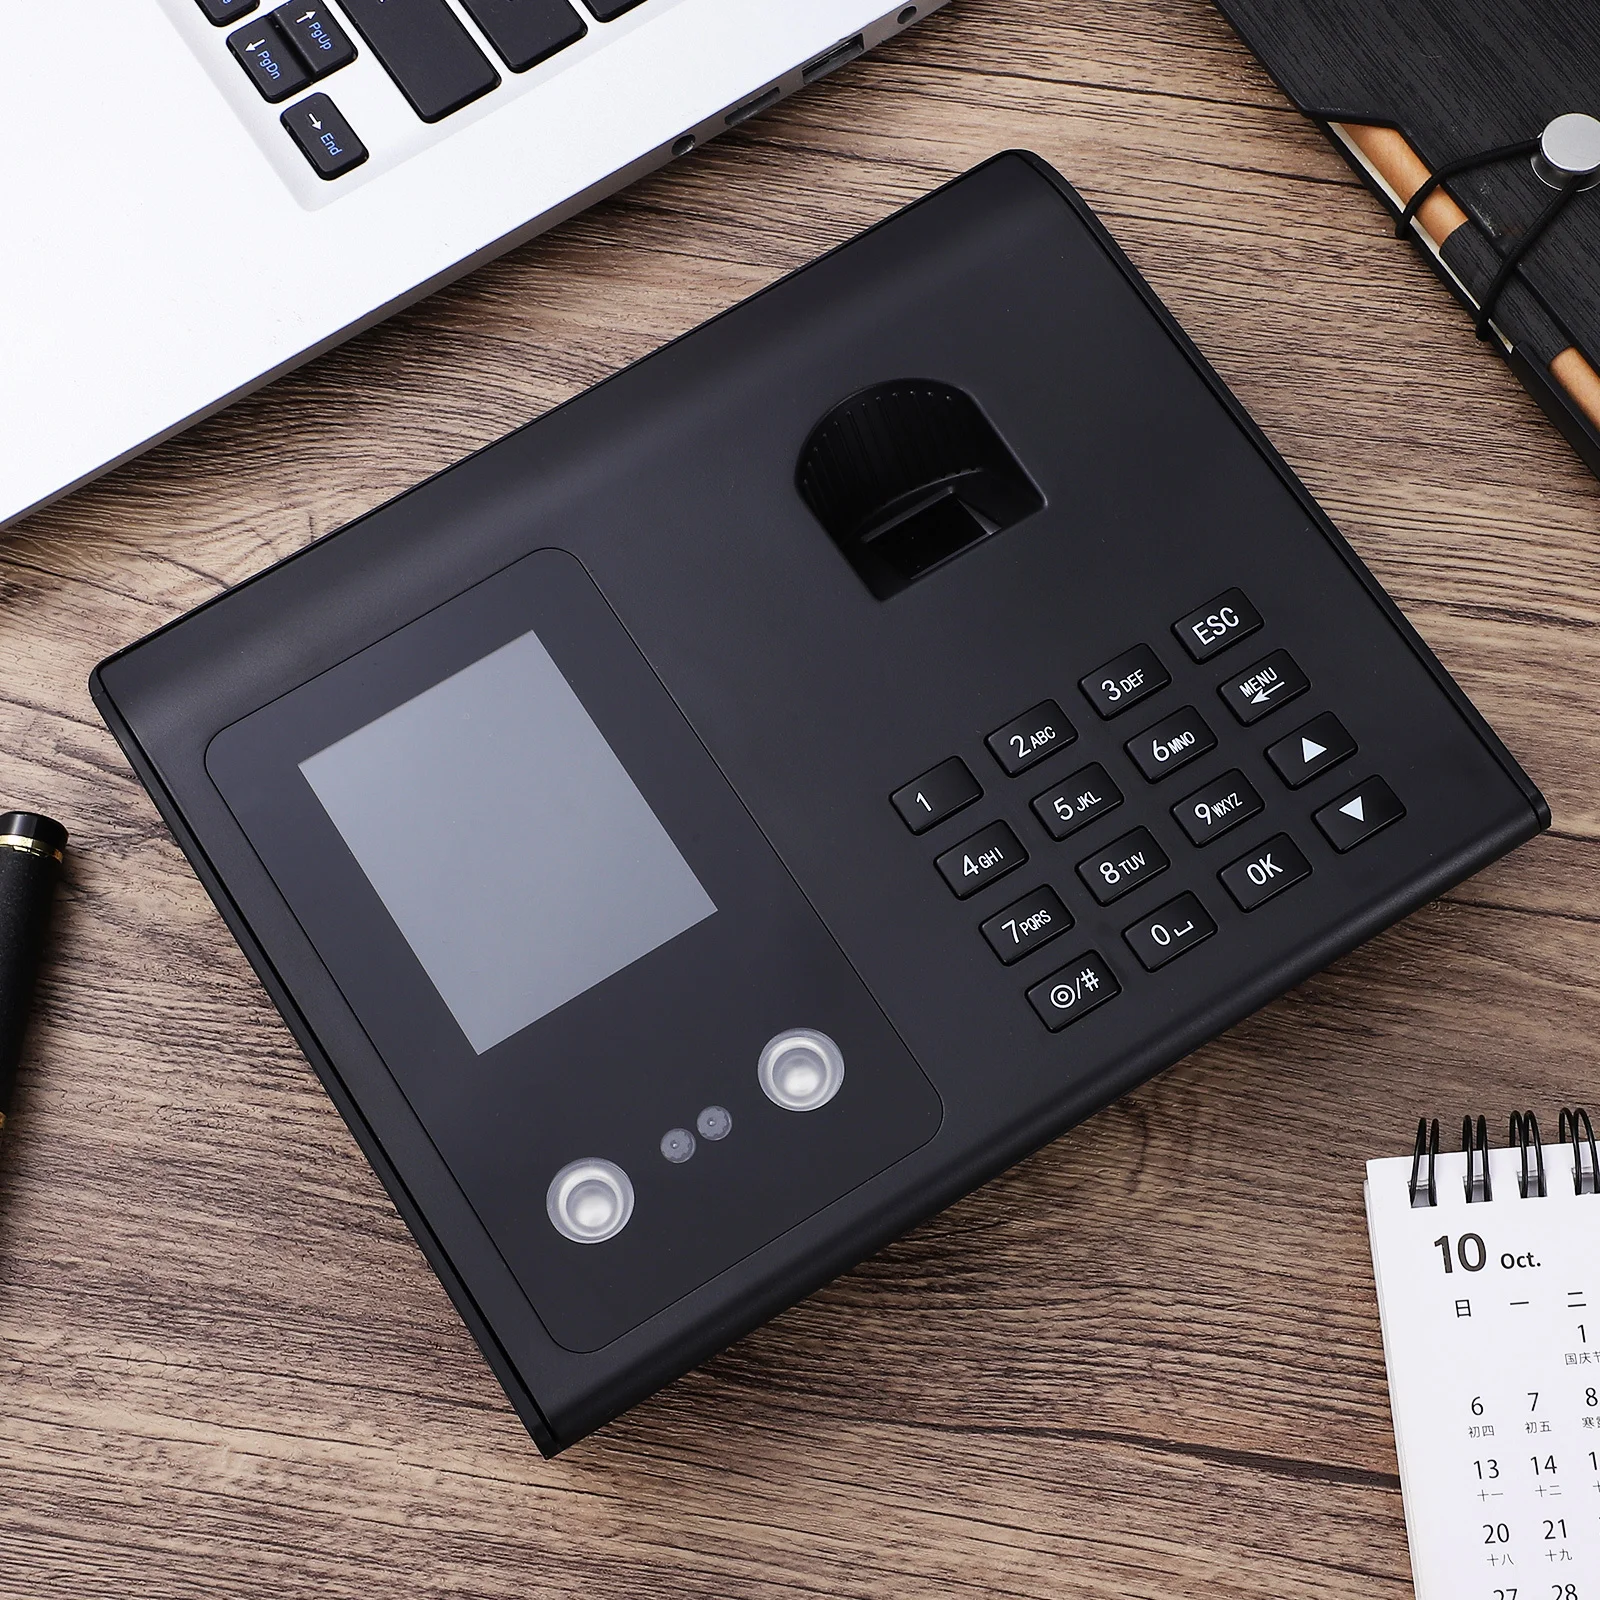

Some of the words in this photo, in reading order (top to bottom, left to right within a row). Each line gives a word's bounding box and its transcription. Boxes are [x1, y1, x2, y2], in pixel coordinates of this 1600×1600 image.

[309, 22, 332, 50] PgUp
[258, 51, 281, 79] PgDn
[320, 133, 342, 156] End
[1191, 607, 1240, 646] ESC
[1101, 679, 1122, 701] 3
[1119, 668, 1146, 693] DEF
[1238, 666, 1279, 699] MENU
[1009, 735, 1032, 758] 2
[1029, 726, 1056, 750] ABC
[1152, 739, 1170, 762] 6
[1166, 731, 1196, 755] MNO
[915, 792, 932, 812] 1
[1053, 796, 1074, 821] 5
[1076, 791, 1102, 812] JKL
[1194, 803, 1212, 825] 9
[1210, 792, 1243, 818] WXYZ
[963, 854, 980, 877] 4
[978, 846, 1004, 869] GHI
[1099, 861, 1121, 884] 8
[1117, 851, 1146, 875] TUV
[1246, 853, 1284, 886] OK
[1001, 919, 1021, 944] 7
[1018, 909, 1052, 936] PQRS
[1433, 1232, 1487, 1274] 10
[1500, 1252, 1542, 1270] Oct.
[1454, 1299, 1472, 1318] 日
[1567, 1291, 1587, 1308] 二
[1577, 1324, 1587, 1343] 1
[1471, 1396, 1484, 1416] 6
[1527, 1391, 1539, 1412] 7
[1585, 1387, 1599, 1407] 8
[1468, 1425, 1495, 1438] 初四
[1524, 1420, 1552, 1434] 初五
[1473, 1459, 1500, 1480] 13
[1530, 1455, 1558, 1476] 14
[1477, 1489, 1504, 1502] 十一
[1534, 1484, 1562, 1498] 十二
[1482, 1523, 1510, 1544] 20
[1542, 1519, 1567, 1540] 21
[1486, 1553, 1514, 1567] 十八
[1545, 1548, 1573, 1562] 十九
[1551, 1583, 1578, 1600] 28
